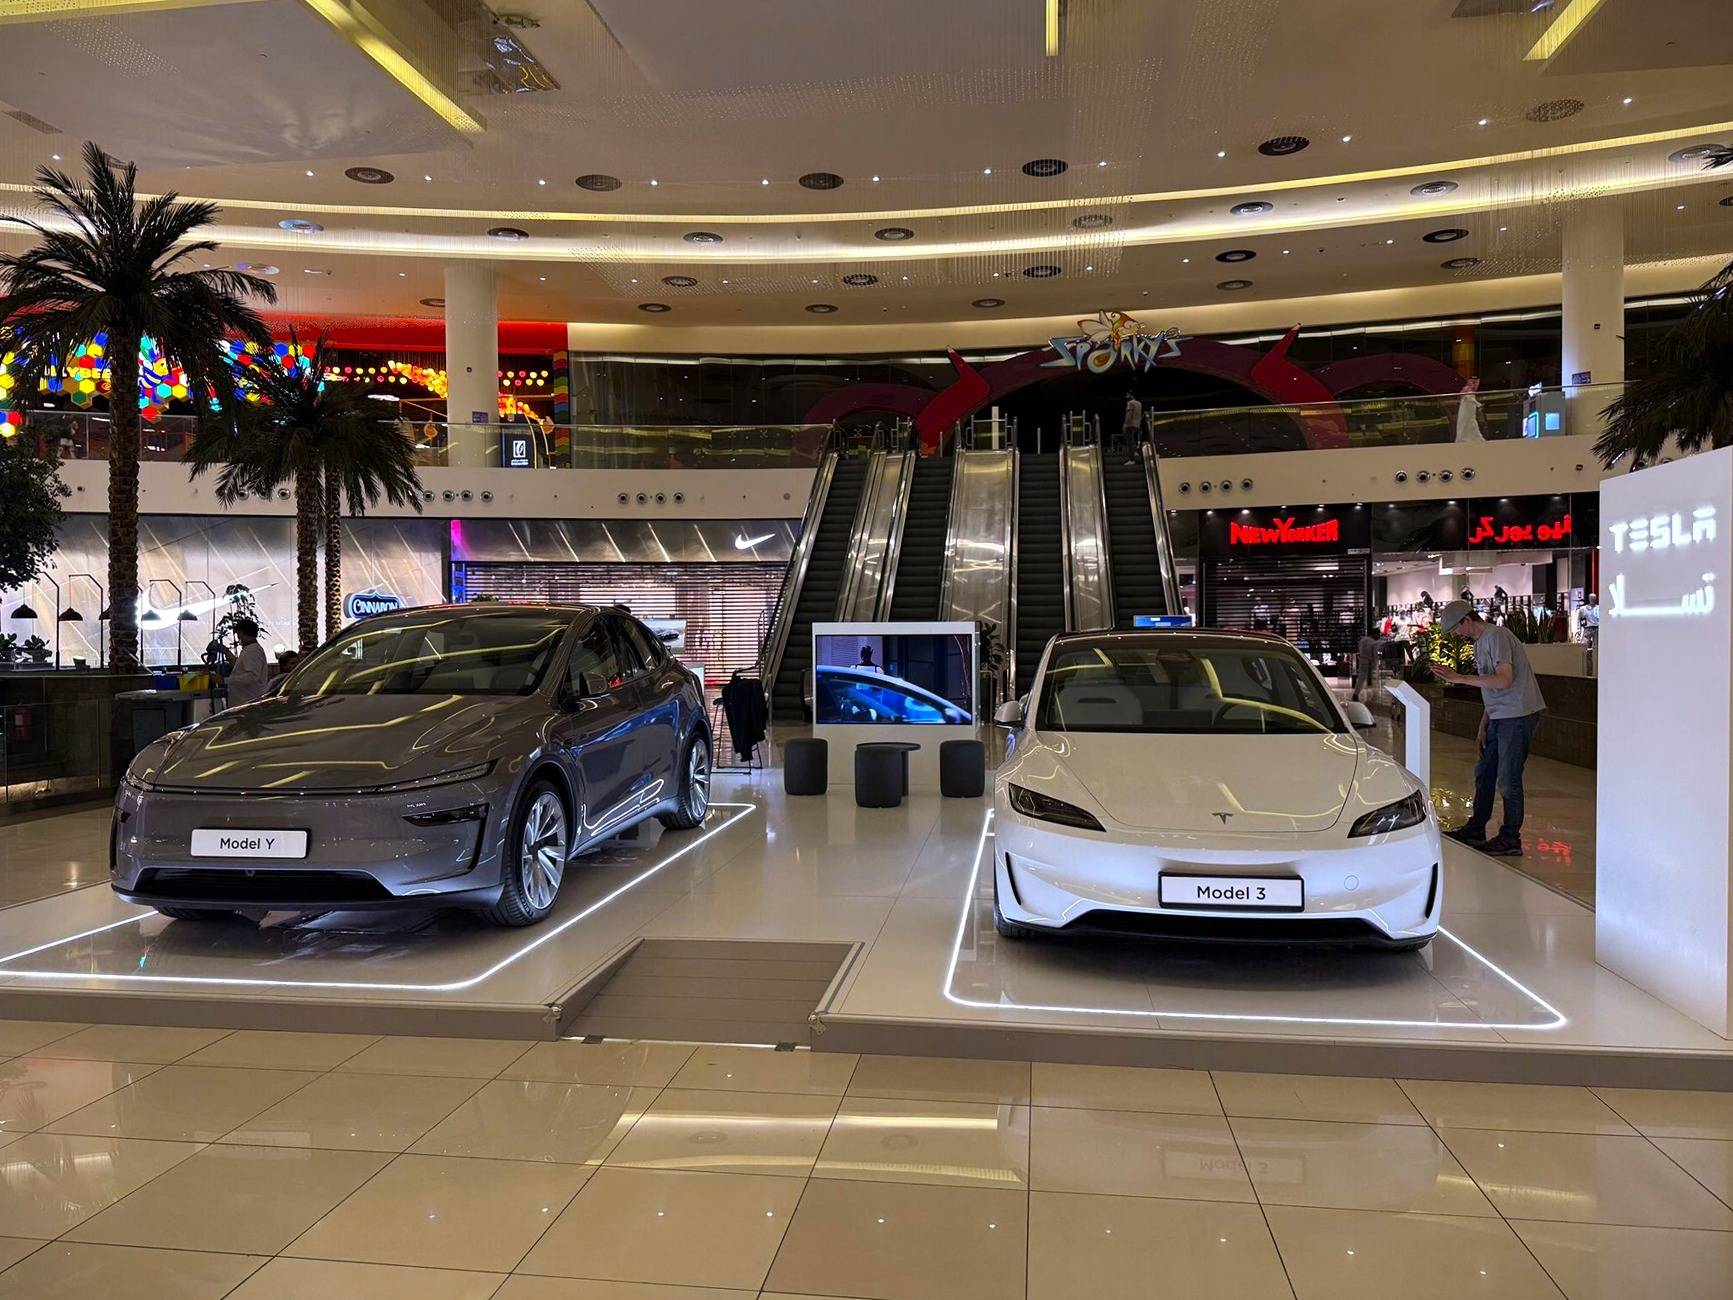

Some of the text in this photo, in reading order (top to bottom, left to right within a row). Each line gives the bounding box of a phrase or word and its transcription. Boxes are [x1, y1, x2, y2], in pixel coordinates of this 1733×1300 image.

[1608, 506, 1716, 554] TESLA
[1608, 573, 1716, 617] تسلا
[219, 837, 275, 849] Model Y
[1197, 886, 1266, 900] Model 3
